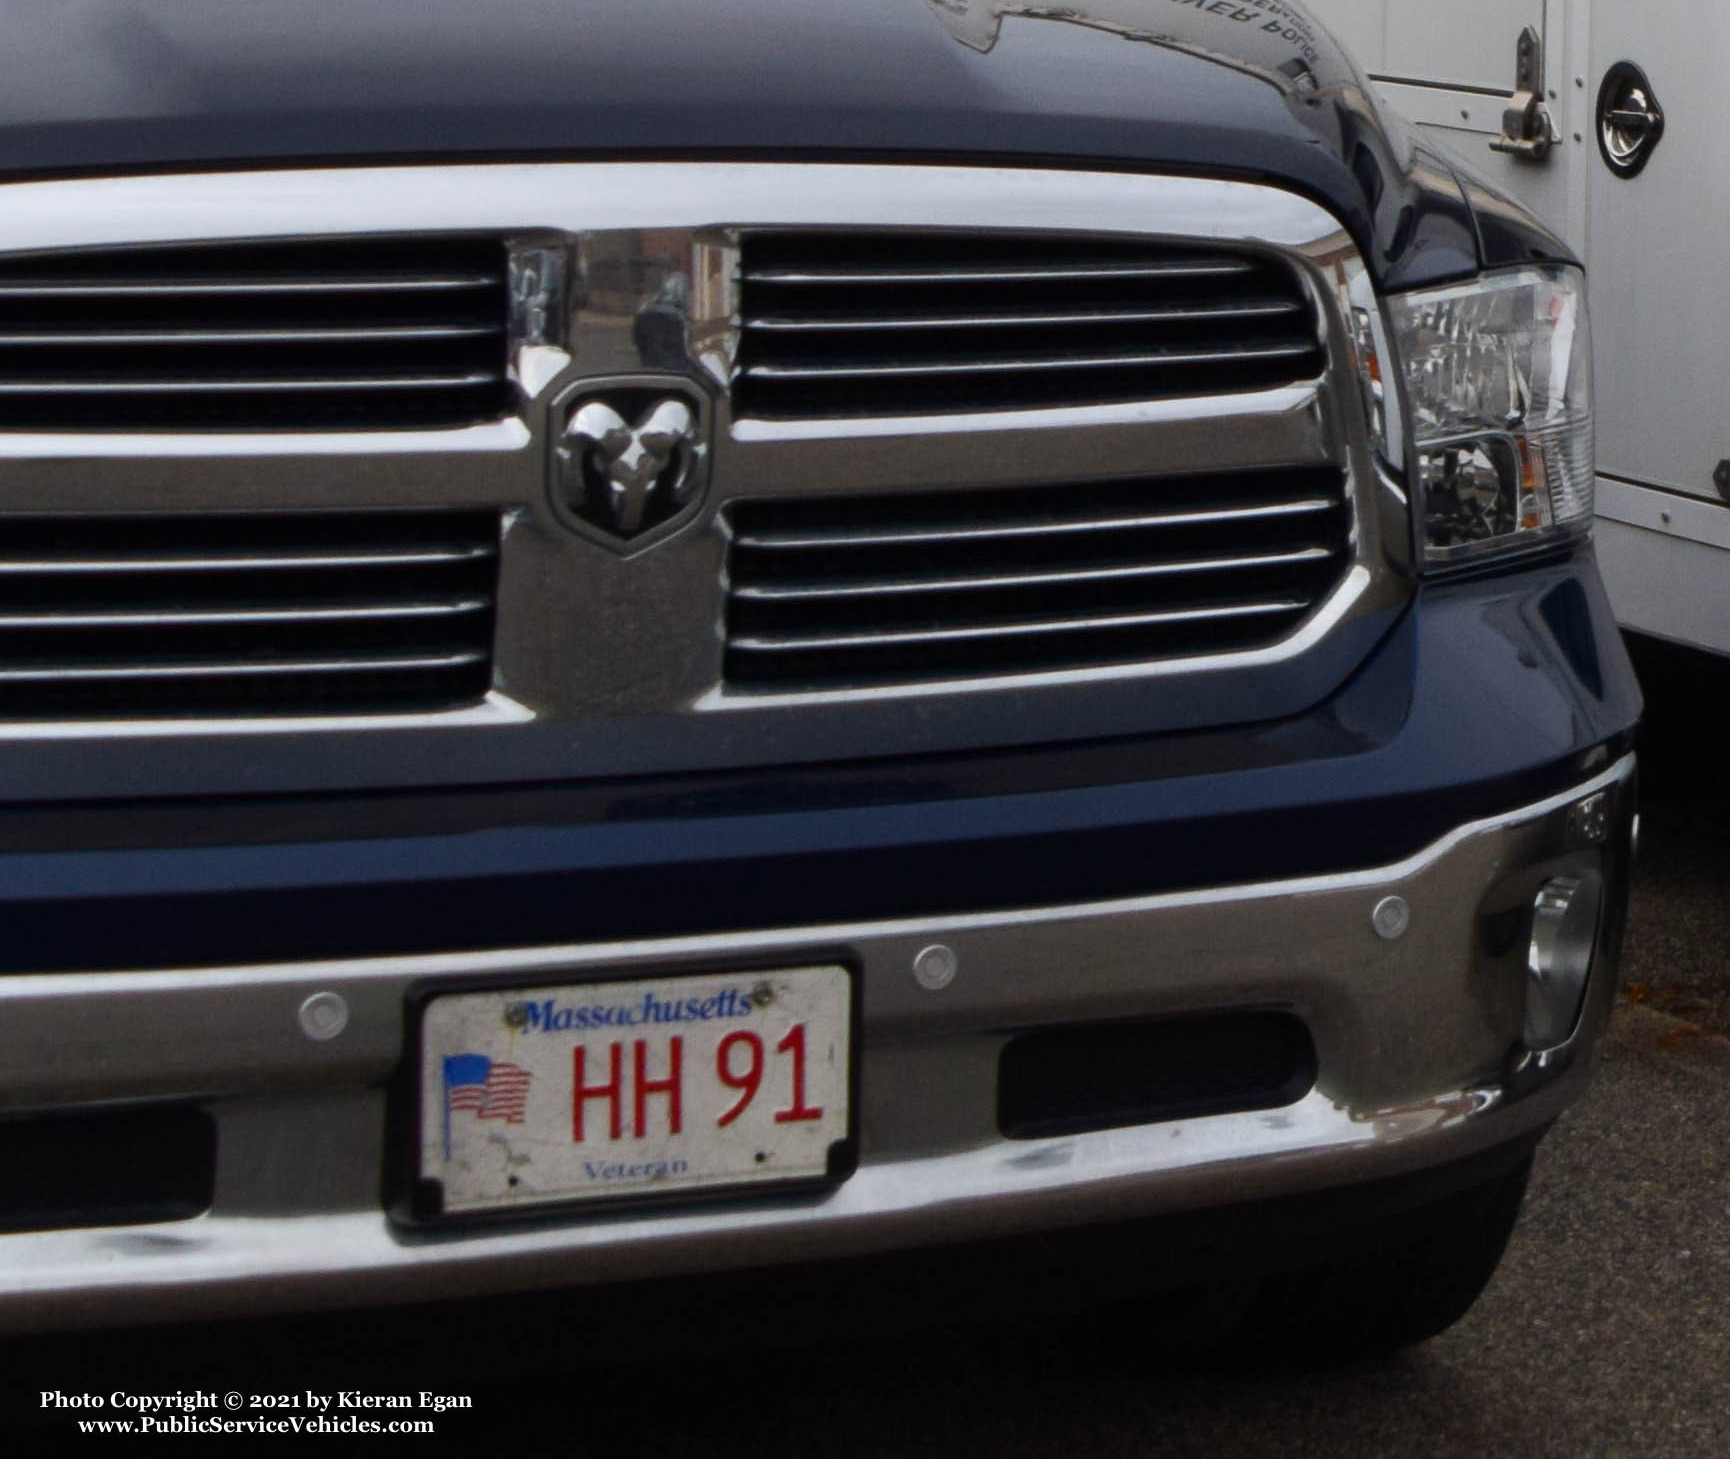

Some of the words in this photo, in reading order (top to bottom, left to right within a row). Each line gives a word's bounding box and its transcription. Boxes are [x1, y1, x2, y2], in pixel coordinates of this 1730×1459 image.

[522, 988, 753, 1034] Massachusetts
[572, 1036, 683, 1142] HH
[716, 1023, 823, 1128] 91
[583, 1157, 688, 1181] Veteran
